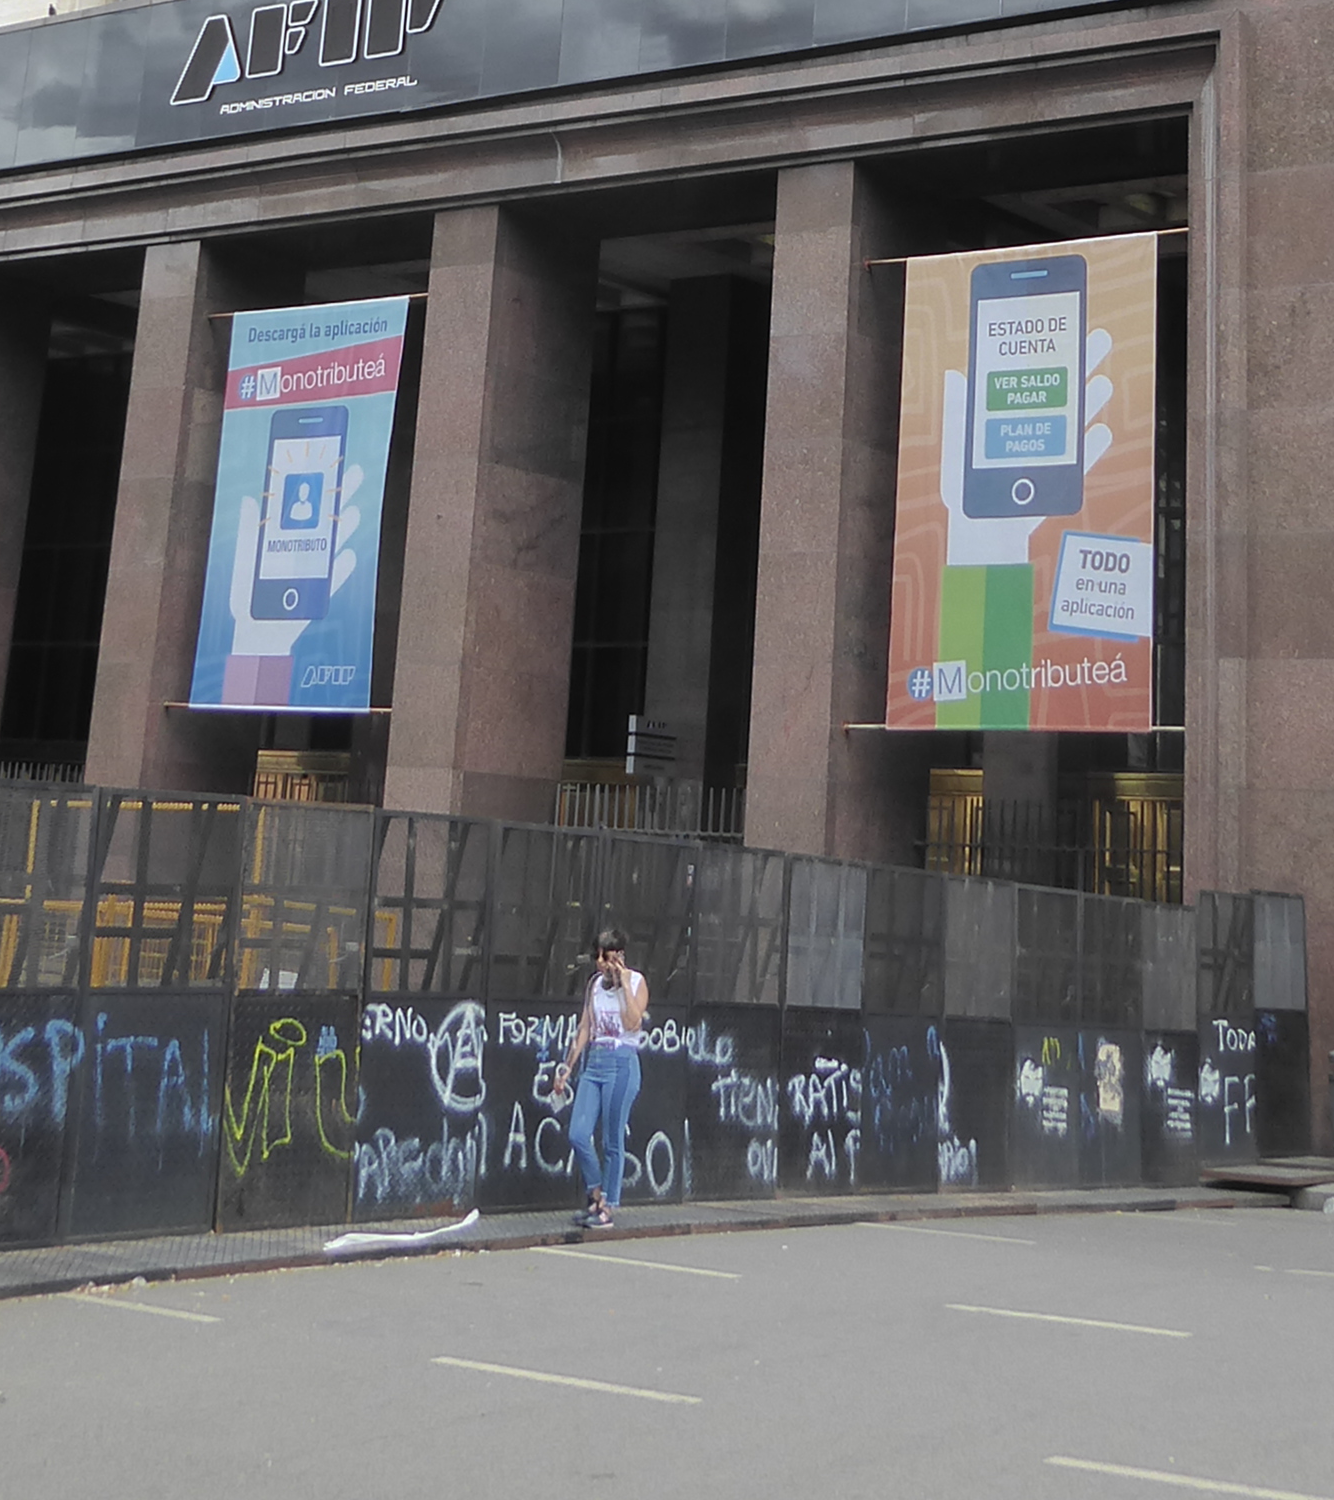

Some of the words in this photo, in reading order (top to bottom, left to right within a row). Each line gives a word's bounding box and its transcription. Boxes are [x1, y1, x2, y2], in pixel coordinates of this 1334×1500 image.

[220, 86, 336, 114] ADMINISTRACION
[344, 75, 418, 97] FEDERAL
[248, 324, 306, 344] Descargá
[309, 323, 321, 339] la
[324, 317, 388, 341] aplicación
[988, 319, 1045, 337] ESTADO
[1048, 317, 1067, 332] DE
[999, 338, 1056, 356] CUENTA
[241, 353, 386, 399] #Monotributeá
[994, 376, 1018, 389] VER
[1020, 373, 1060, 388] SALDO
[1007, 390, 1046, 405] PAGAR
[1000, 424, 1032, 437] PLAN
[1035, 422, 1051, 435] DE
[1005, 439, 1045, 452] PAGOS
[267, 538, 327, 553] MONOTRIBUTO
[1079, 549, 1130, 573] TODO
[1075, 578, 1094, 592] en
[1098, 580, 1126, 595] una
[1061, 598, 1134, 620] aplicación
[912, 652, 1127, 698] #Monotributeá
